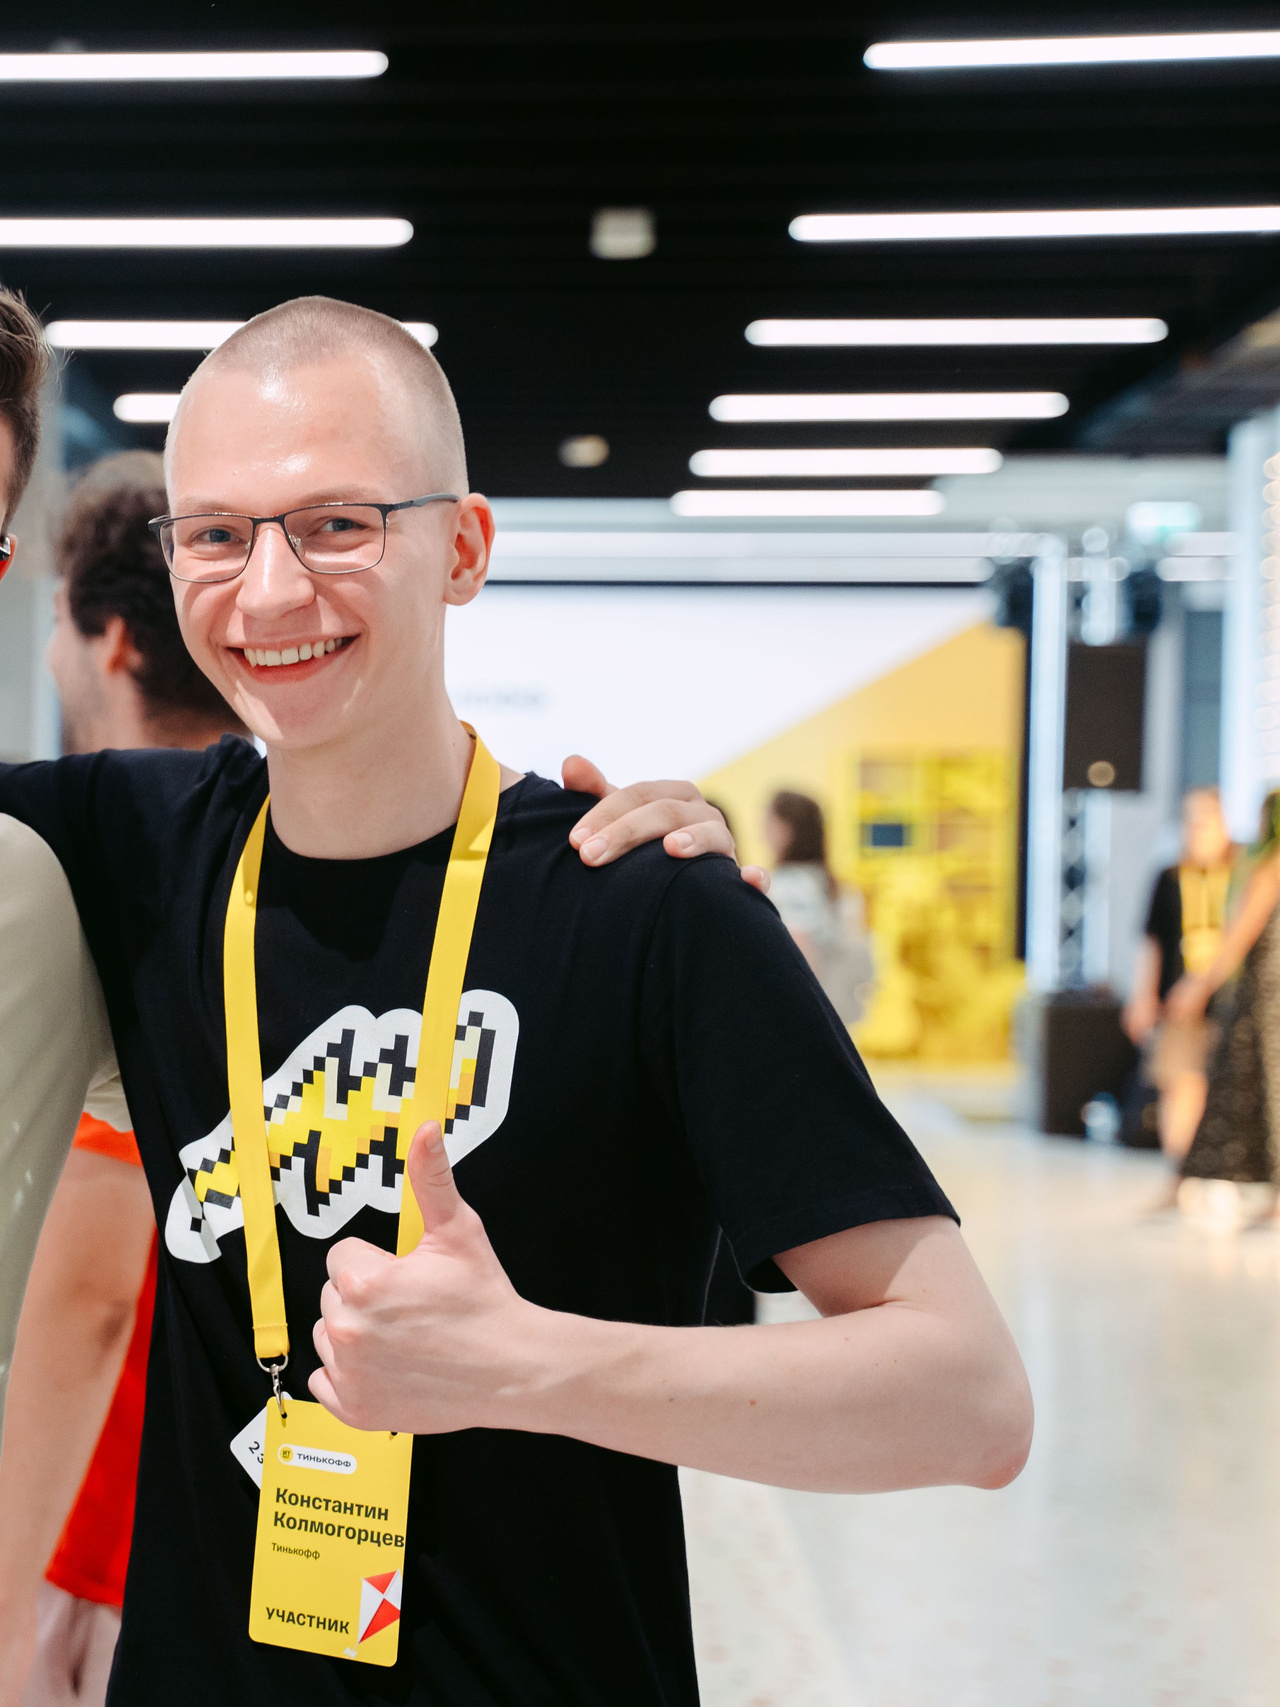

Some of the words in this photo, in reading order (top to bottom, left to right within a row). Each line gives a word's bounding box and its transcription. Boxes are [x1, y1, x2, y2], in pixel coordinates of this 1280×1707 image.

[297, 1452, 352, 1468] ТИНЬКОФФ
[275, 1487, 389, 1521] Константин
[273, 1511, 406, 1549] Колмогорцев
[271, 1542, 321, 1561] Тинькофф
[265, 1606, 350, 1635] УЧАСТНИК
